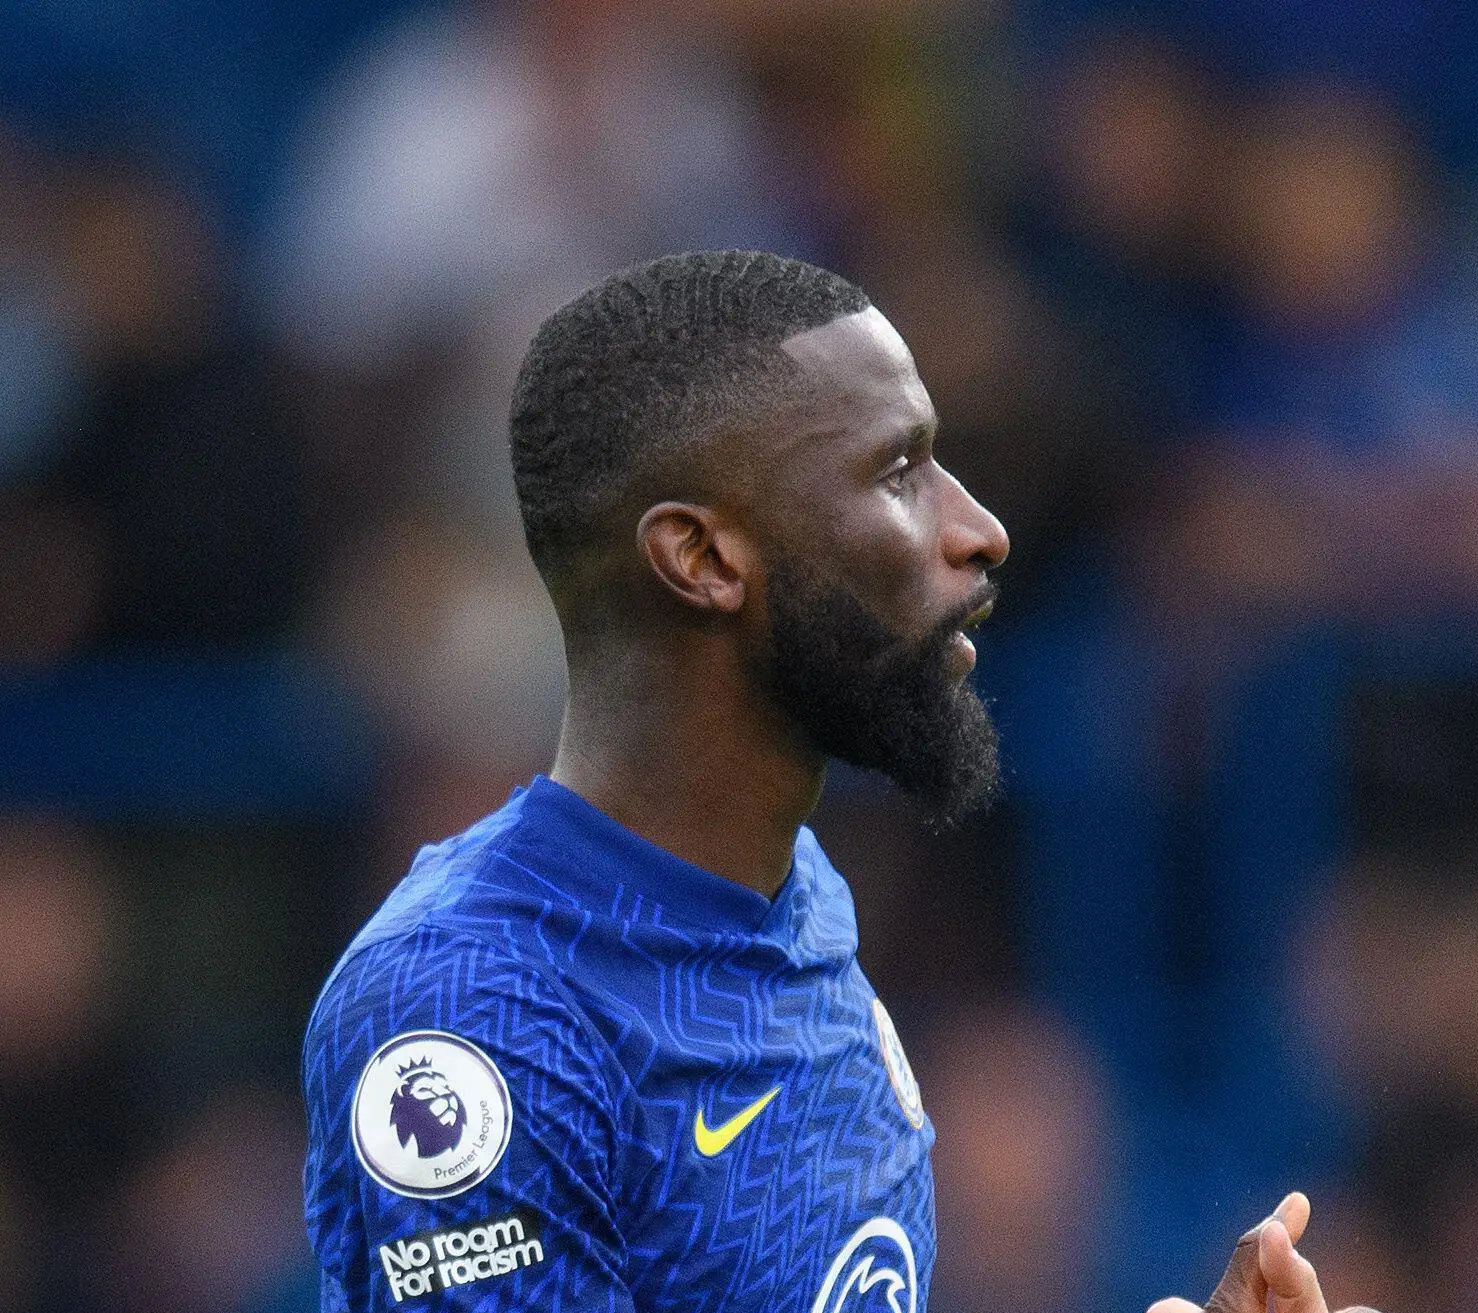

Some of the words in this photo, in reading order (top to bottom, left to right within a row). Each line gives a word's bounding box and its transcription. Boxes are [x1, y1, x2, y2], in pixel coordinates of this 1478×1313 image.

[433, 1148, 478, 1180] Premier
[474, 1100, 494, 1152] League
[379, 1240, 431, 1277] No
[433, 1218, 525, 1261] room
[437, 1239, 545, 1288] racism
